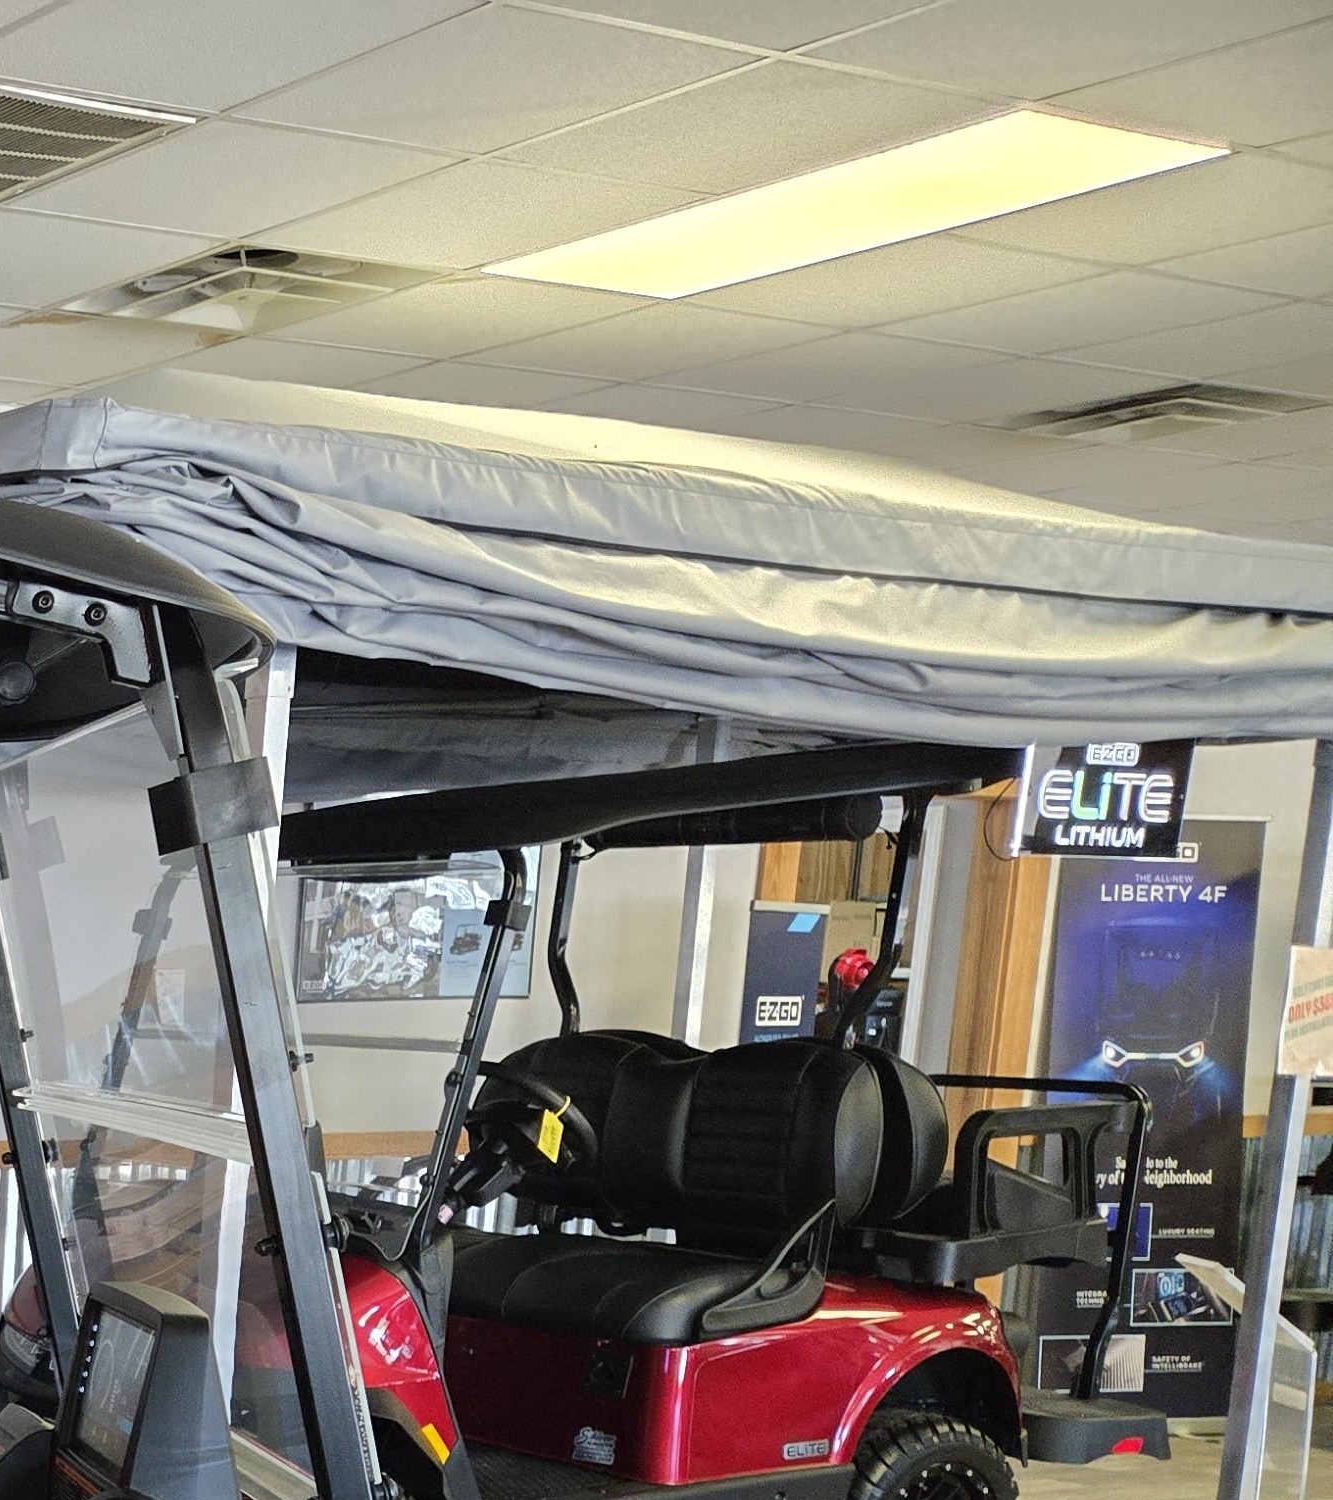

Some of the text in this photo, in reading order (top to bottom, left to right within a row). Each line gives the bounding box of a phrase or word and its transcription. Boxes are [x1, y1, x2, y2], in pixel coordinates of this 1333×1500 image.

[1054, 824, 1145, 848] LITHIUM
[1135, 873, 1194, 883] THE ALL-NEW
[1100, 883, 1228, 903] LIBERTY 4F
